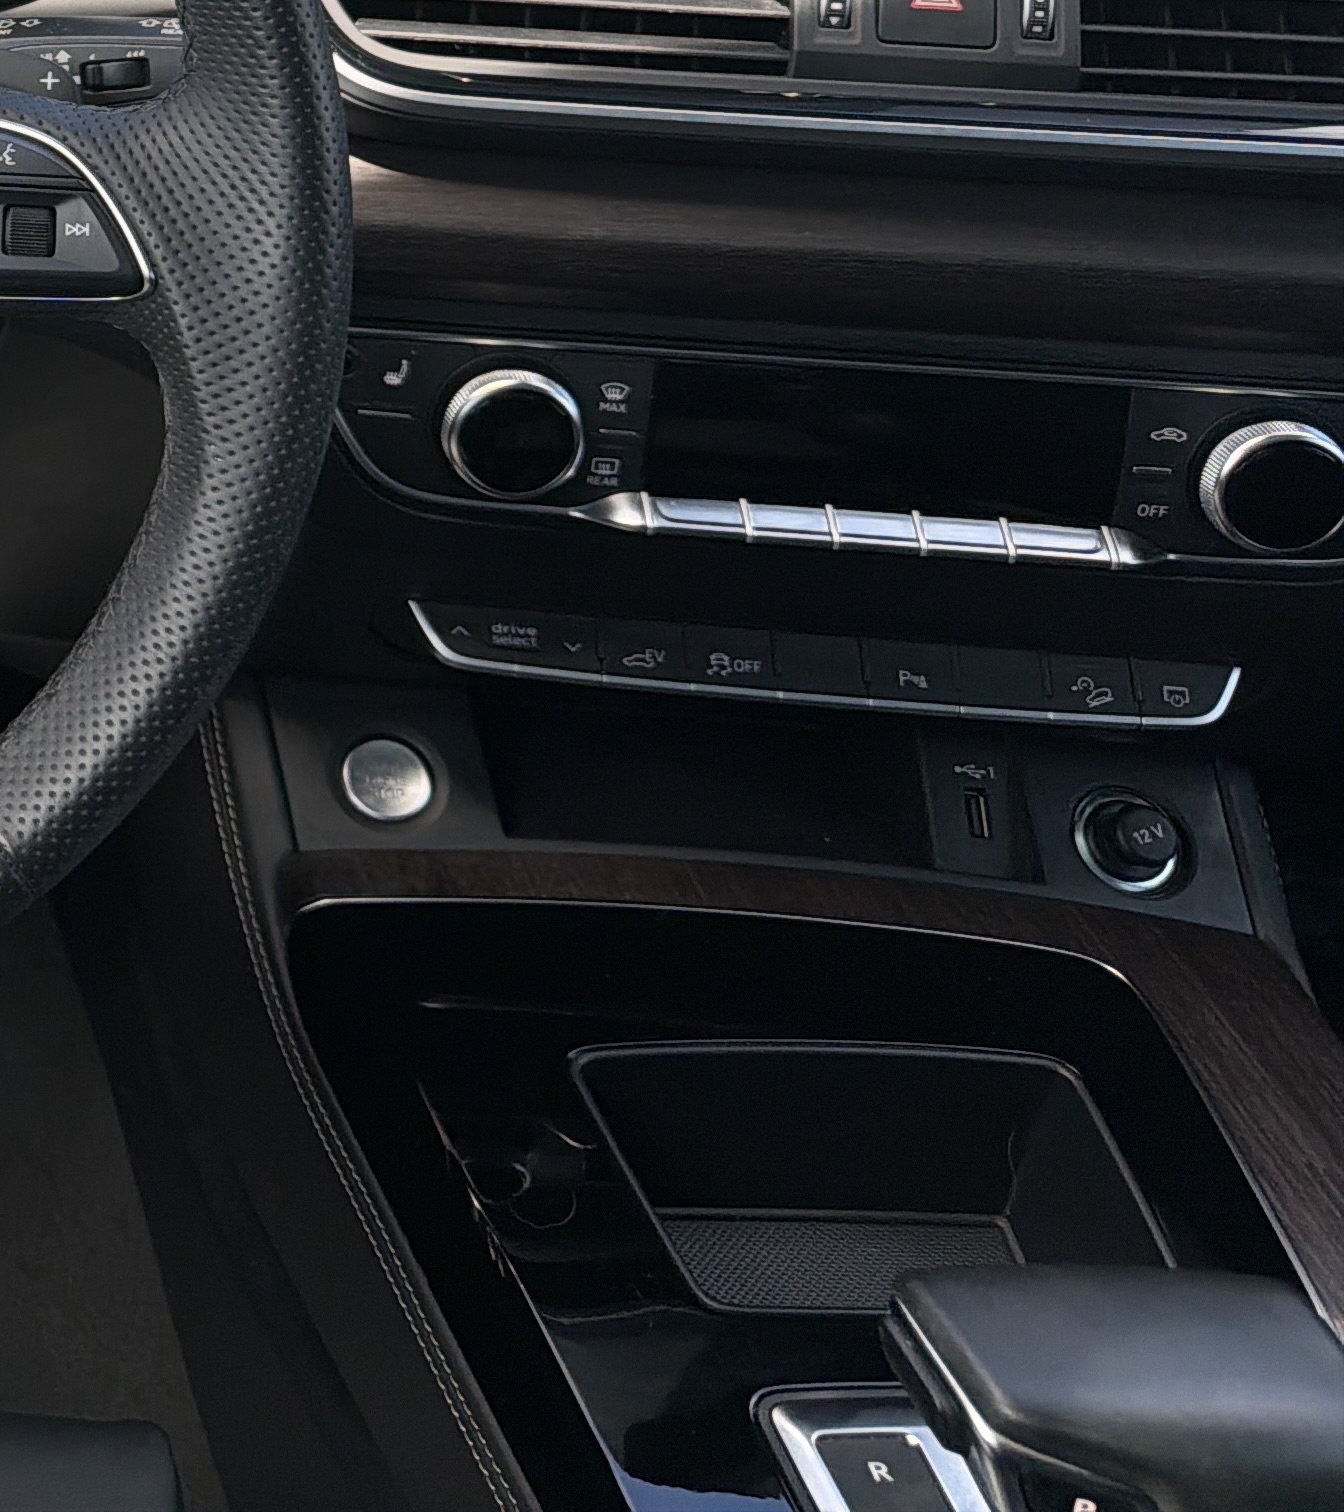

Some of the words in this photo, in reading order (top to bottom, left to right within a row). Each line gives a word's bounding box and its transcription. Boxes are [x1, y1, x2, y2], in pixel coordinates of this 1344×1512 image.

[598, 400, 627, 414] MAX
[586, 474, 620, 487] REAR
[1137, 504, 1170, 520] OFF
[491, 622, 538, 636] drive
[492, 634, 539, 647] select
[645, 648, 666, 662] EV
[733, 659, 762, 673] OFF
[867, 1460, 895, 1483] R
